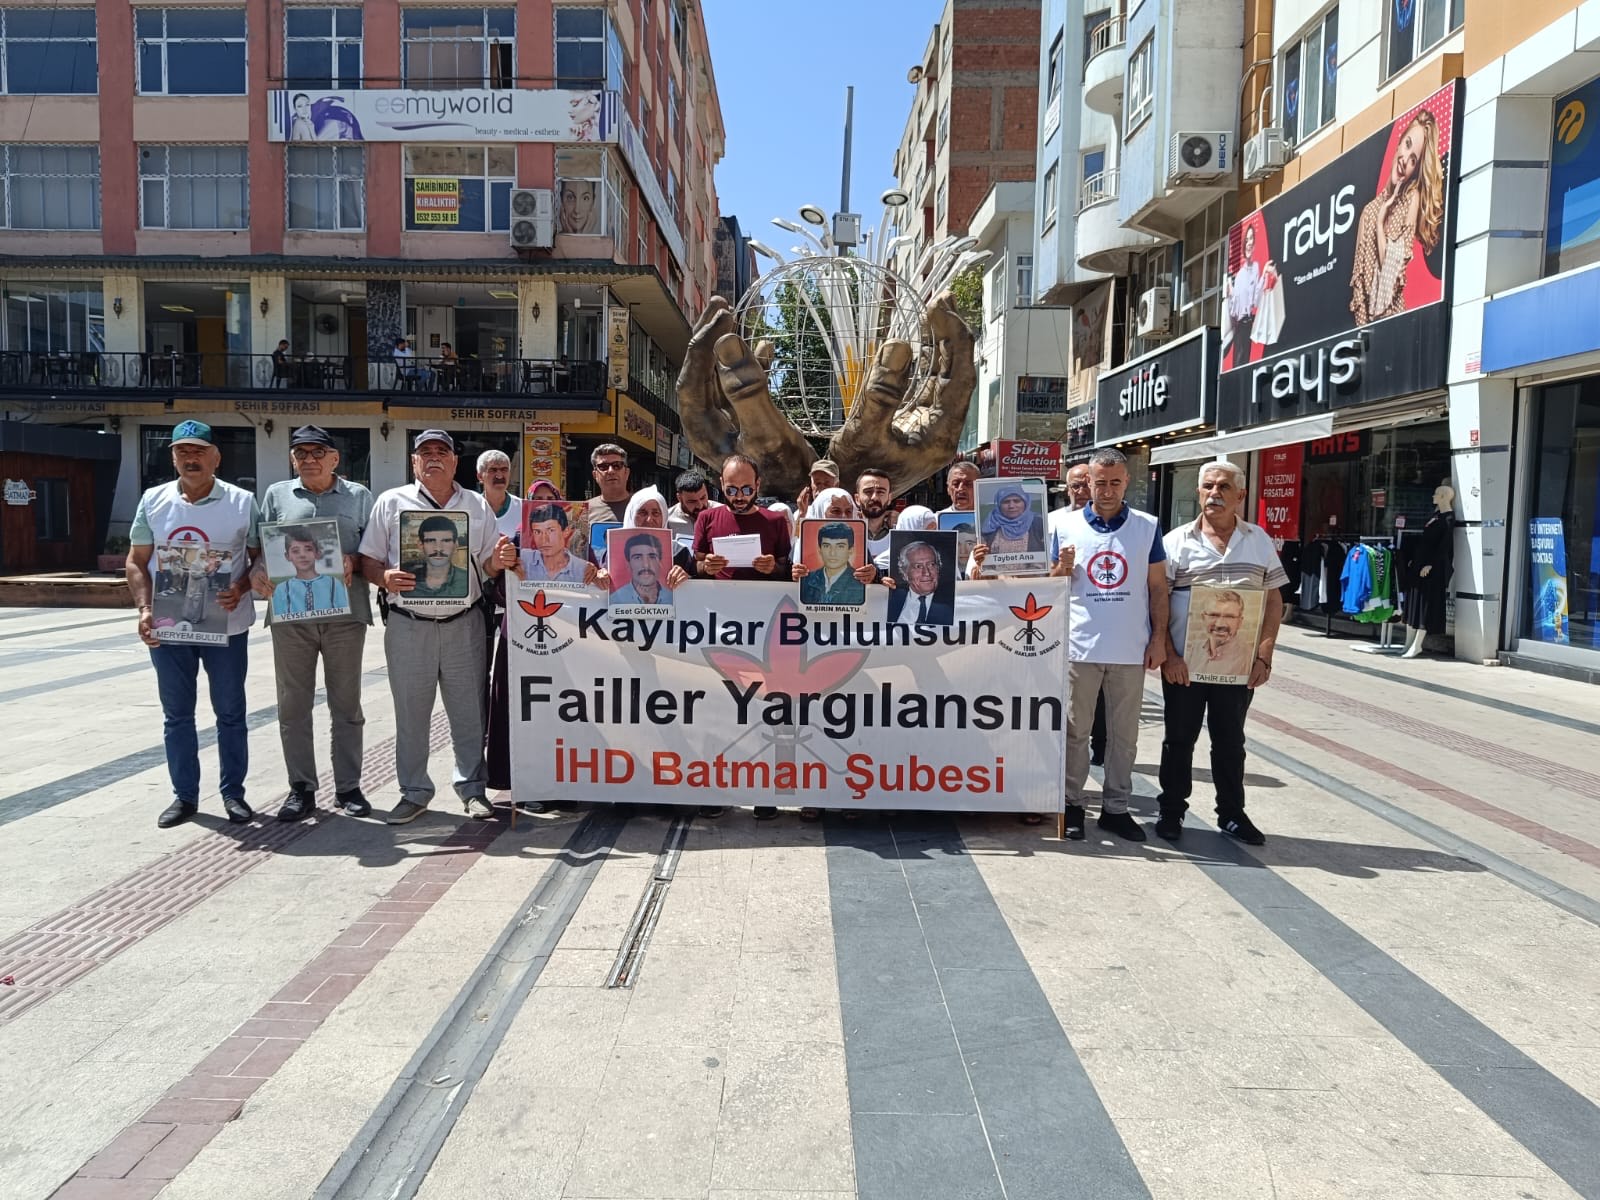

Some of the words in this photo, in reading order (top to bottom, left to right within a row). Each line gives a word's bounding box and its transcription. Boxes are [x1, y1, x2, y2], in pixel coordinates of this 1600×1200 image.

[475, 127, 497, 136] beauty
[503, 128, 529, 136] medical
[1218, 134, 1226, 168] BEKO
[1283, 184, 1355, 263] rays
[1252, 341, 1355, 403] rays
[1119, 362, 1168, 417] stilife
[487, 410, 536, 419] SOFRASI
[1002, 455, 1057, 466] Collection
[1010, 443, 1049, 458] Şirin
[280, 610, 309, 620] VEYSEL
[310, 607, 344, 617] ATILGAN
[615, 607, 632, 615] Eset
[156, 631, 194, 640] MERYEM
[195, 633, 225, 641] BULUT
[578, 607, 764, 653] Kayıplar
[779, 612, 995, 647] Bulunsun
[519, 674, 706, 726] Failler
[721, 679, 1062, 740] Yargılansın
[555, 738, 635, 785] İHD
[653, 750, 828, 790] Batman
[846, 752, 1004, 800] Şubesi
